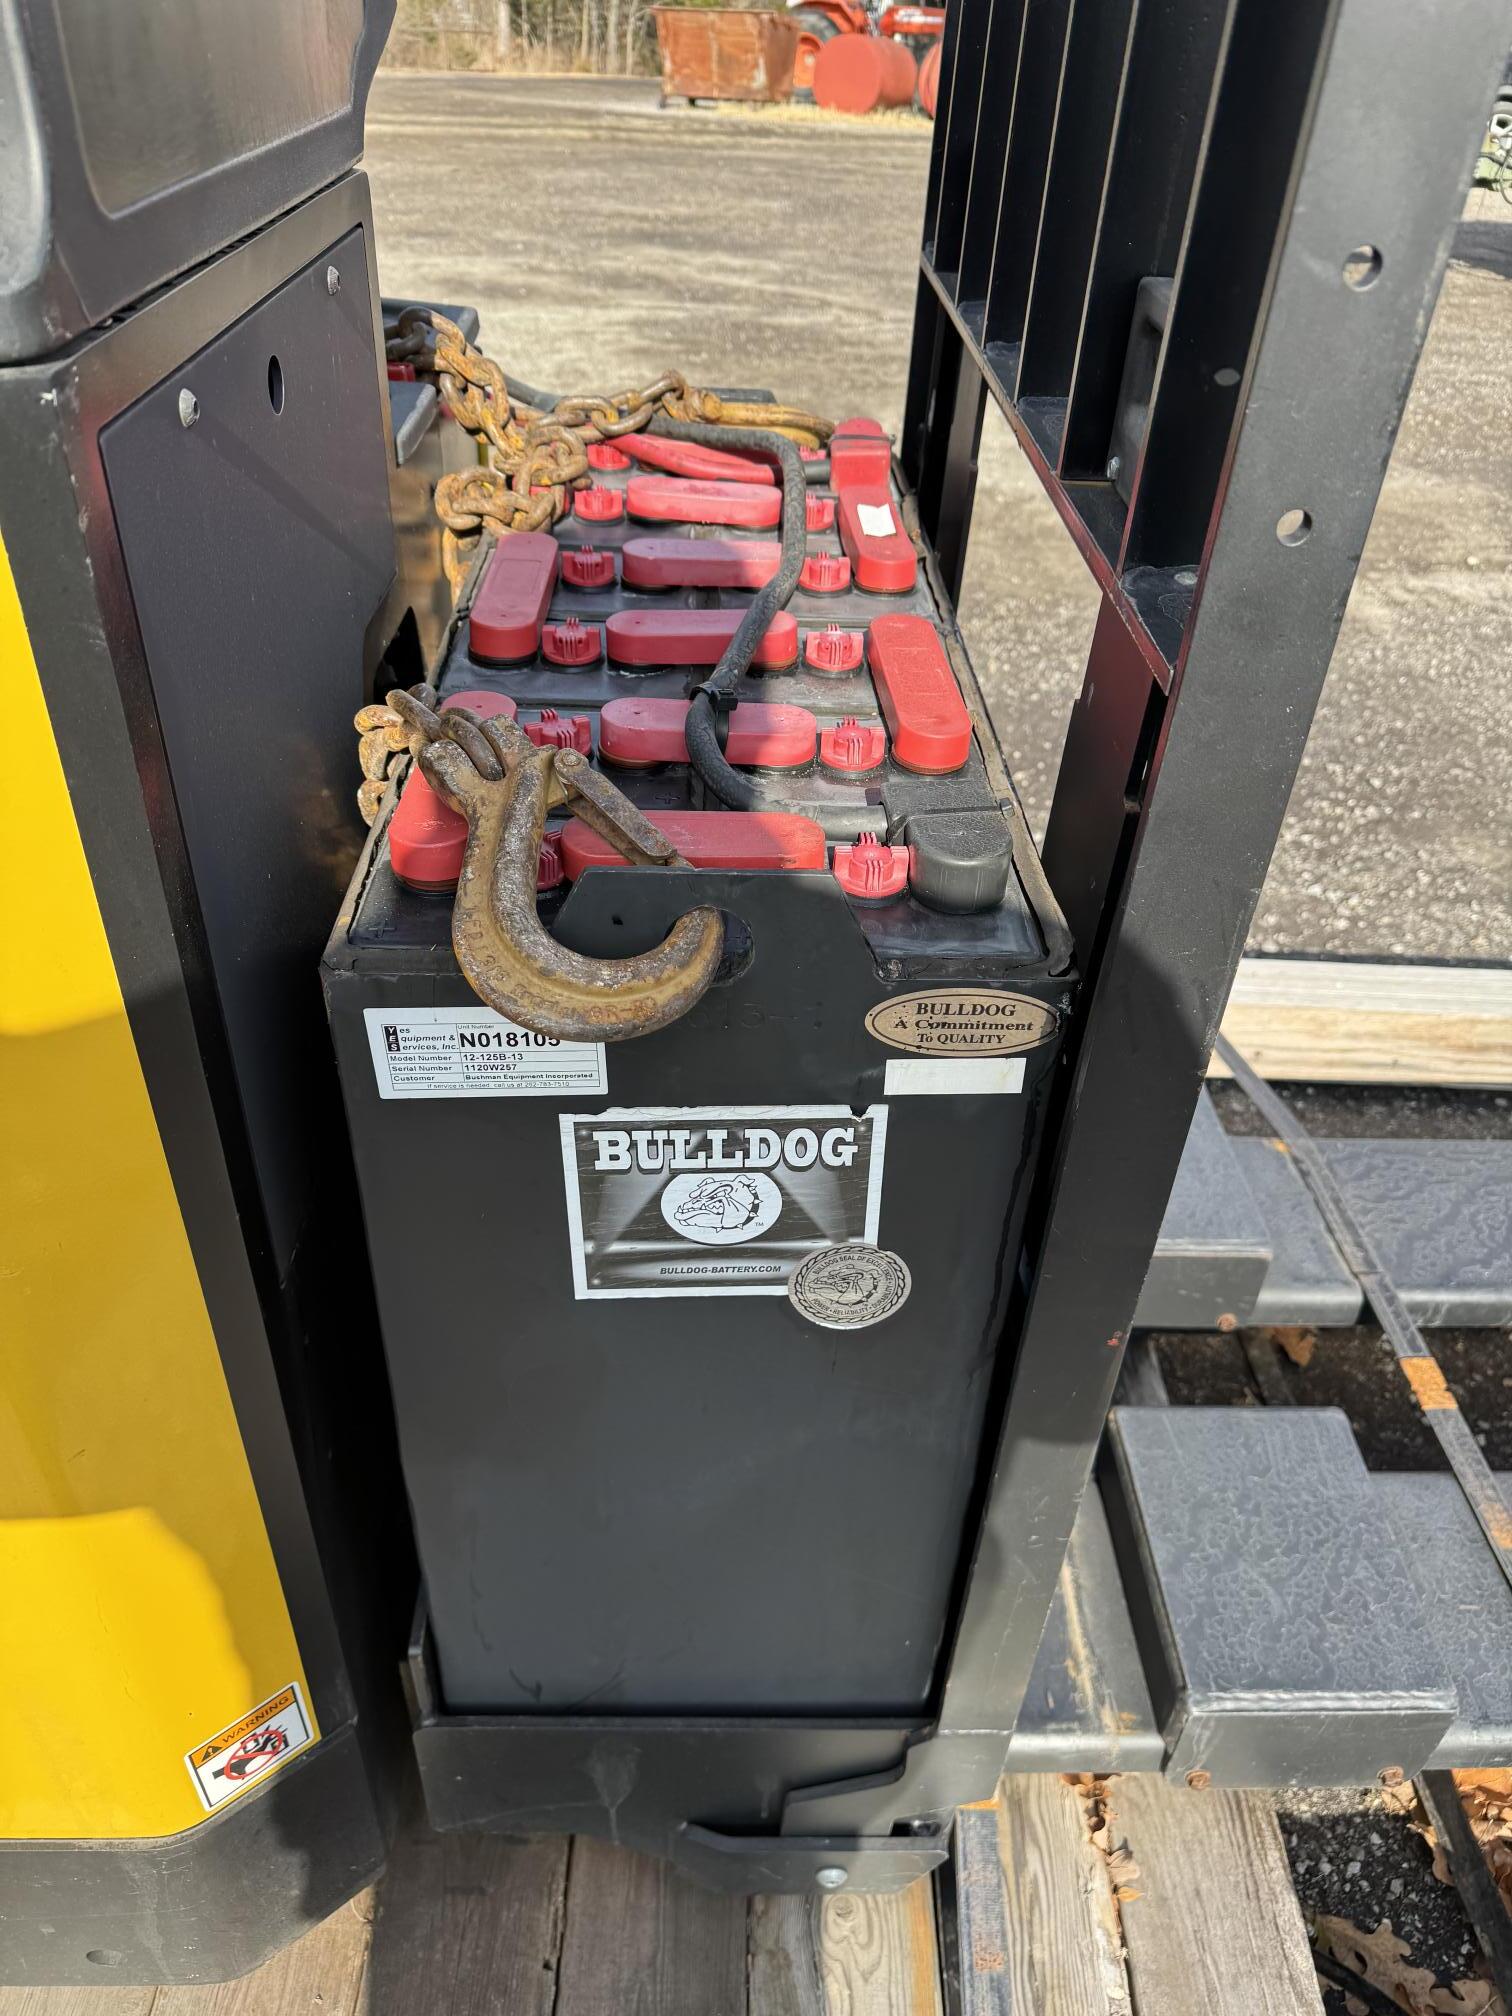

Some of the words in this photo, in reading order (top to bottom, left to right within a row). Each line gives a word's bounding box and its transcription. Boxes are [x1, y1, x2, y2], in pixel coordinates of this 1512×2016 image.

[915, 1003, 1017, 1016] BULLDOG
[893, 1019, 908, 1029] A
[915, 1019, 1033, 1031] Commitment
[917, 1033, 933, 1043] To
[938, 1033, 1006, 1044] QUALITY
[463, 1053, 524, 1061] 12-125B-13
[503, 1073, 544, 1081] Equipment
[545, 1072, 593, 1080] Incorporated
[592, 1126, 858, 1172] BULLDOG
[659, 1264, 782, 1275] BULLDOG-BATTERY.COM
[222, 1696, 289, 1743] WARNING
